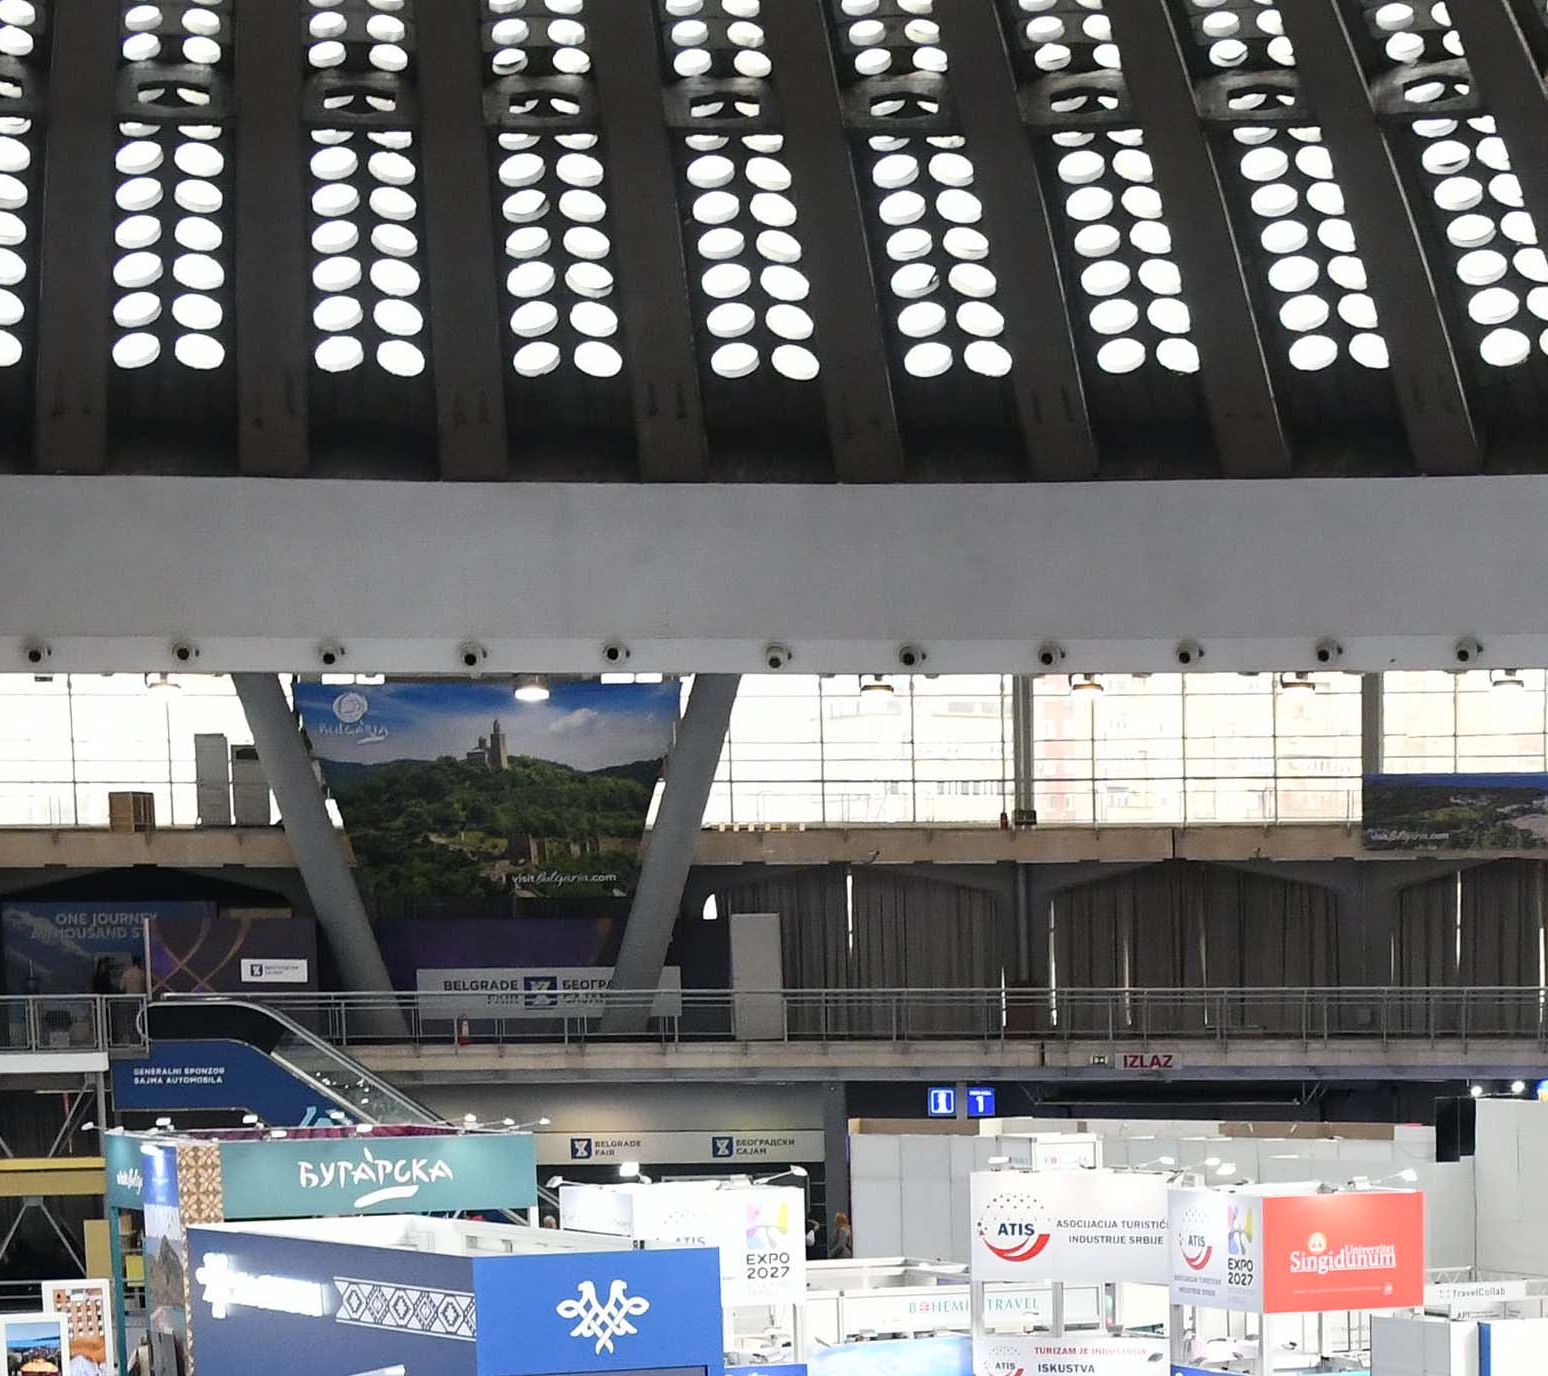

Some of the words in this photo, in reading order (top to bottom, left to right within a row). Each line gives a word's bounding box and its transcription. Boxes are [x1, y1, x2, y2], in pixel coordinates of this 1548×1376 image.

[56, 912, 86, 926] ONE
[1123, 1055, 1173, 1069] IZLAZ
[166, 1076, 223, 1084] AUTOMOBILA
[594, 1140, 641, 1148] BELGRADE
[735, 1138, 795, 1148] БЕОГРАДСКИ
[594, 1149, 616, 1157] FAIR
[735, 1148, 767, 1156] САЈАМ
[298, 1148, 453, 1189] БУГАРСКА
[996, 1223, 1036, 1237] ATIS
[1055, 1219, 1118, 1230] ASOCIJACIJA
[1068, 1234, 1125, 1245] INDUSTRIJE
[1129, 1234, 1165, 1245] SRBIJE
[1187, 1234, 1206, 1248] ATIS
[1344, 1243, 1395, 1256] Univerzitet
[745, 1252, 791, 1266] EXPO
[1227, 1258, 1253, 1272] EXPO
[1289, 1247, 1397, 1275] Singidunum
[746, 1266, 791, 1280] 2027
[1227, 1271, 1253, 1287] 2027
[1451, 1286, 1507, 1300] TravelCollab
[908, 1298, 971, 1314] BOHEMI
[987, 1296, 1040, 1311] TRAVEL
[1034, 1346, 1077, 1356] TURIZAM
[1080, 1346, 1094, 1356] JE
[995, 1361, 1017, 1371] ATIS
[1037, 1362, 1096, 1376] ISKUSTVA
